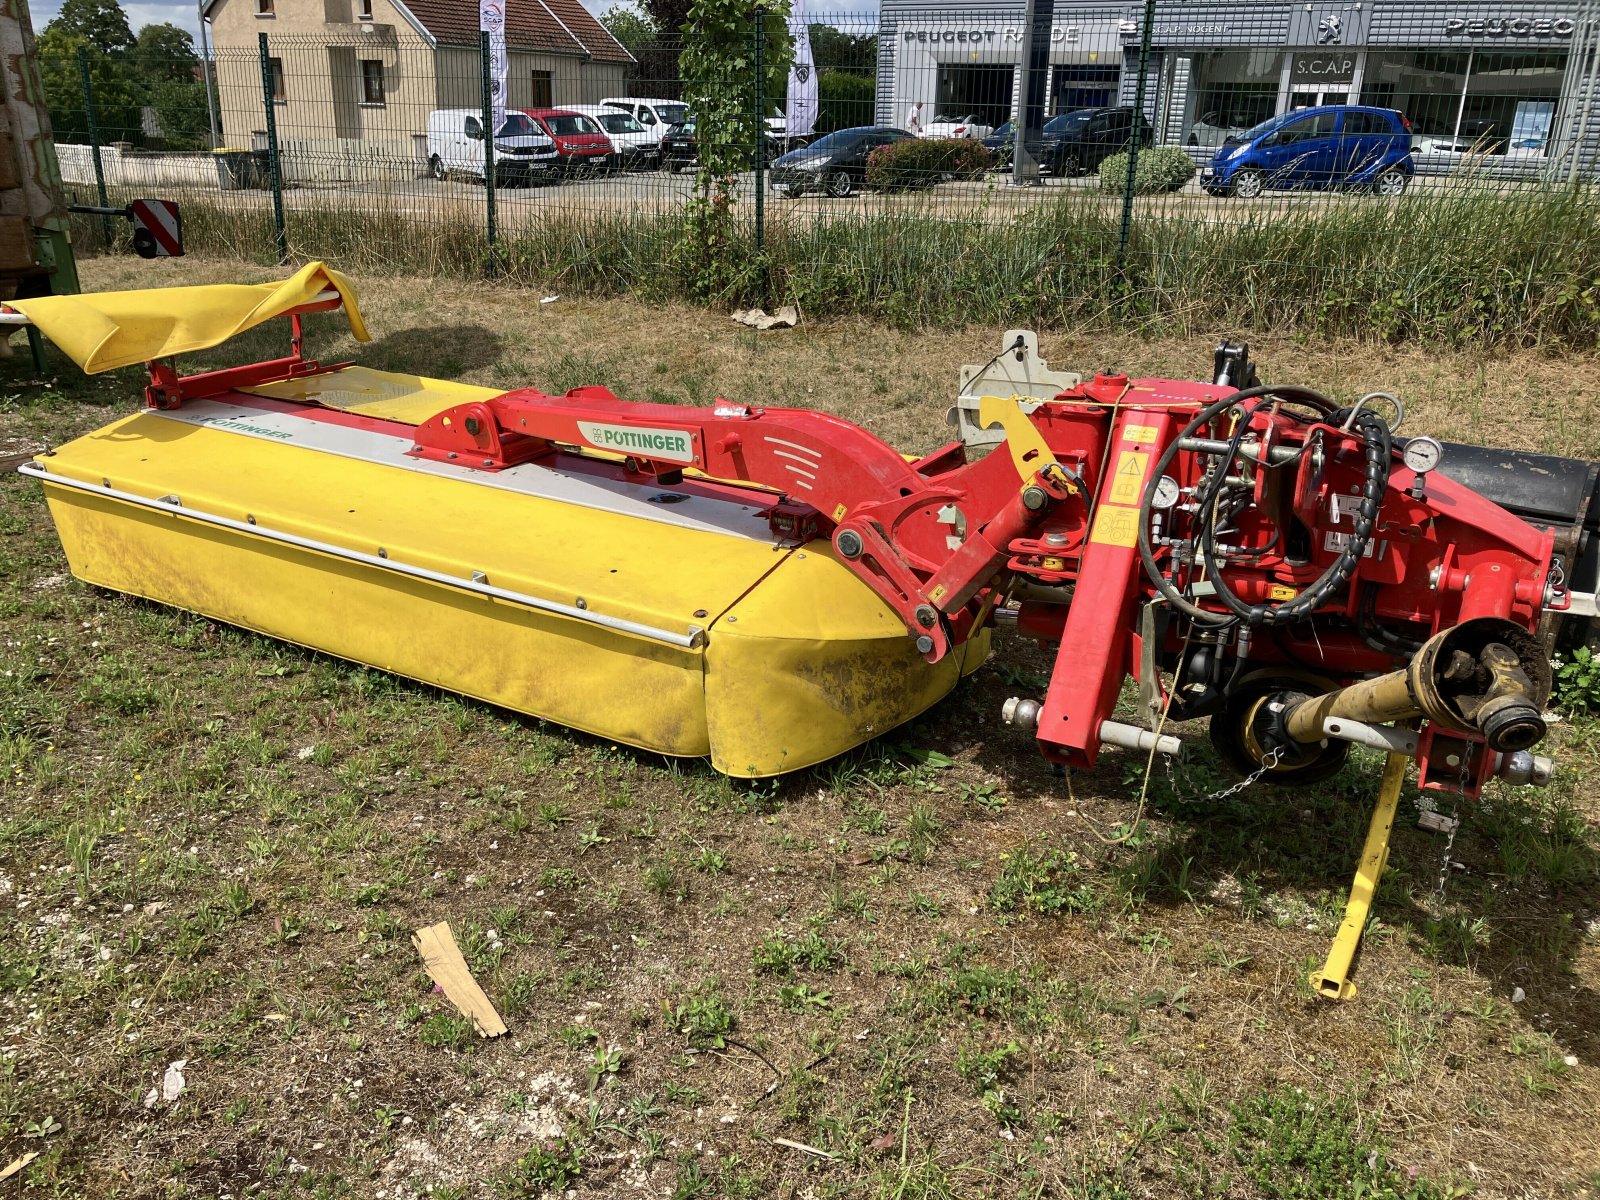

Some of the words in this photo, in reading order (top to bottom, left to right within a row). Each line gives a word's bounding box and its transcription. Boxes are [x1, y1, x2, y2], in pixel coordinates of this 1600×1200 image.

[904, 30, 996, 43] PEUGEOT
[1003, 26, 1079, 42] RADE
[1187, 25, 1229, 33] NOGENT
[1297, 60, 1352, 74] S.C.A.P.
